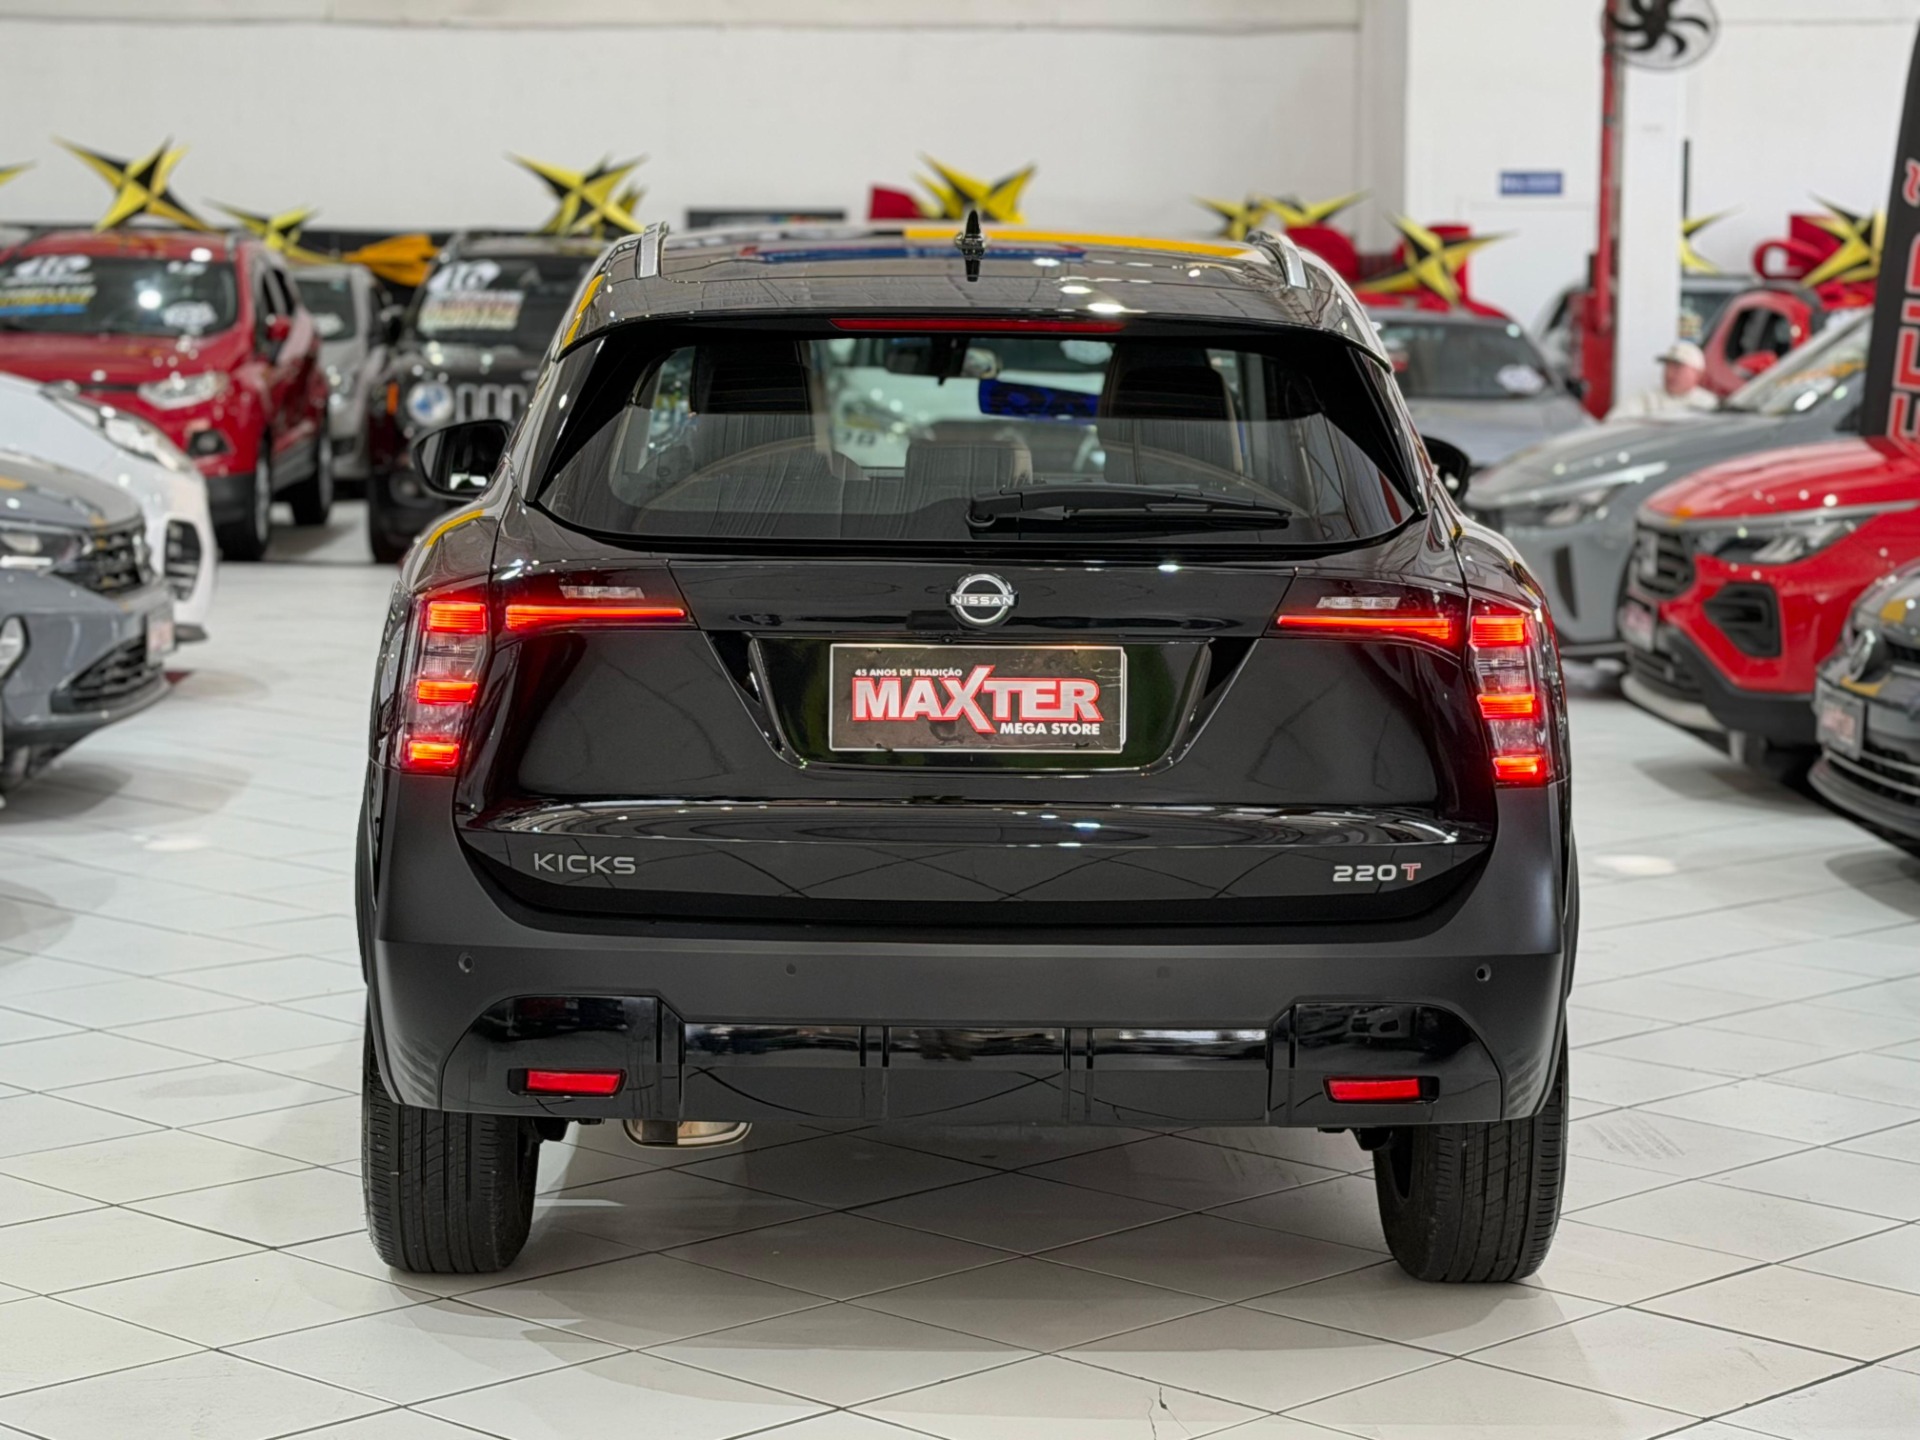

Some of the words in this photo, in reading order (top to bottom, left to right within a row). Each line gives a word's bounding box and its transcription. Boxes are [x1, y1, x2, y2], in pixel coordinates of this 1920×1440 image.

[950, 594, 1015, 606] NISSAN
[855, 669, 868, 677] 45
[869, 669, 898, 677] ANOS
[900, 669, 913, 677] DE
[914, 667, 963, 679] TRADIÇÃO
[852, 664, 1105, 734] MAXTER
[1000, 722, 1048, 735] MEGA
[1051, 722, 1100, 735] STORE
[533, 852, 637, 875] KICKS
[1332, 862, 1422, 882] 220T
